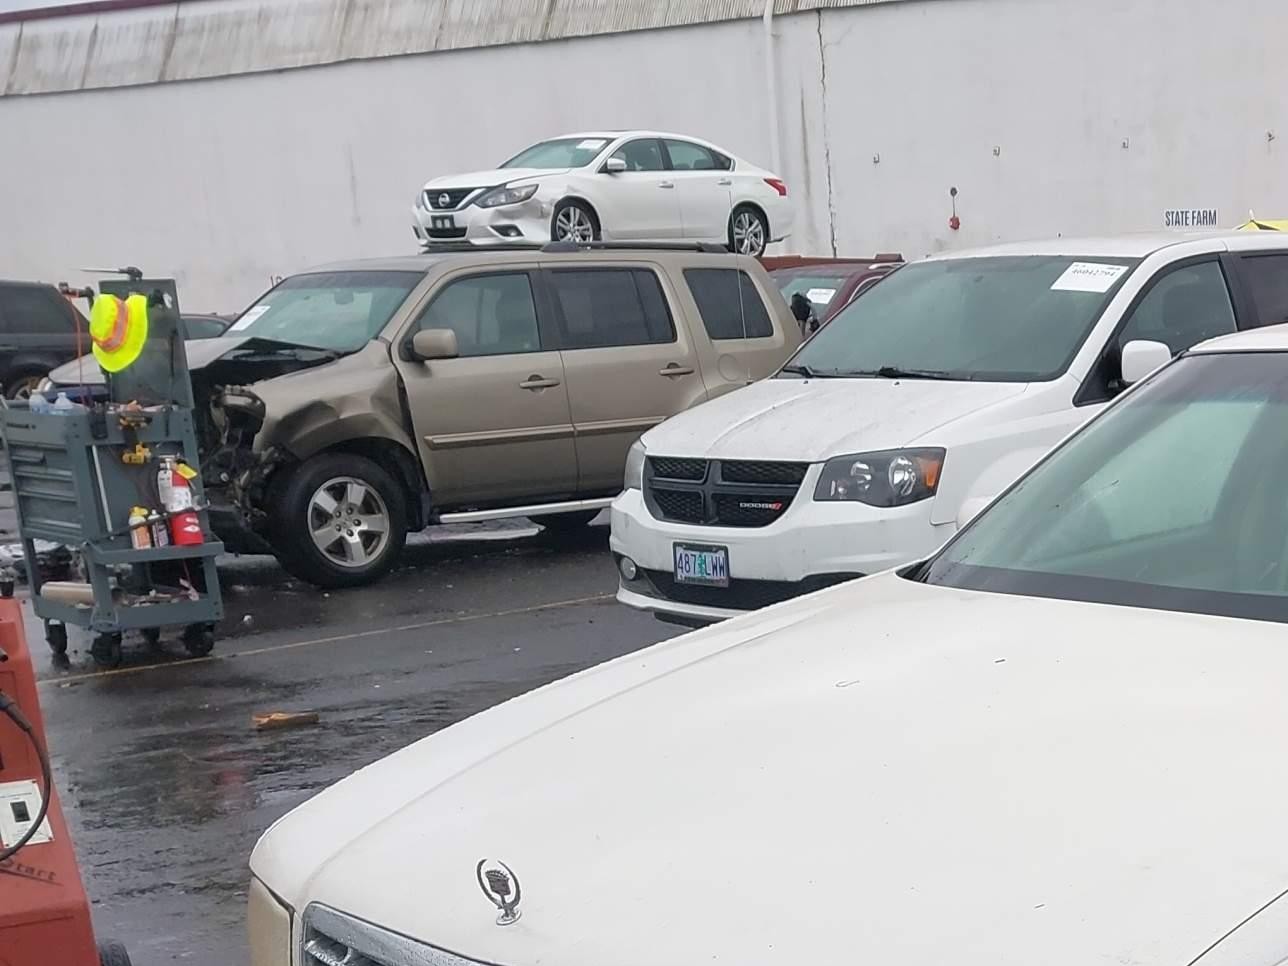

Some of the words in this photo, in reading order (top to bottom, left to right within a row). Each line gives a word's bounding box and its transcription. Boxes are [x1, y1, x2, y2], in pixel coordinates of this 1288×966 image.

[1165, 210, 1190, 226] STATE
[1191, 209, 1217, 226] FARM
[739, 502, 776, 510] DODGE
[677, 552, 698, 575] 487
